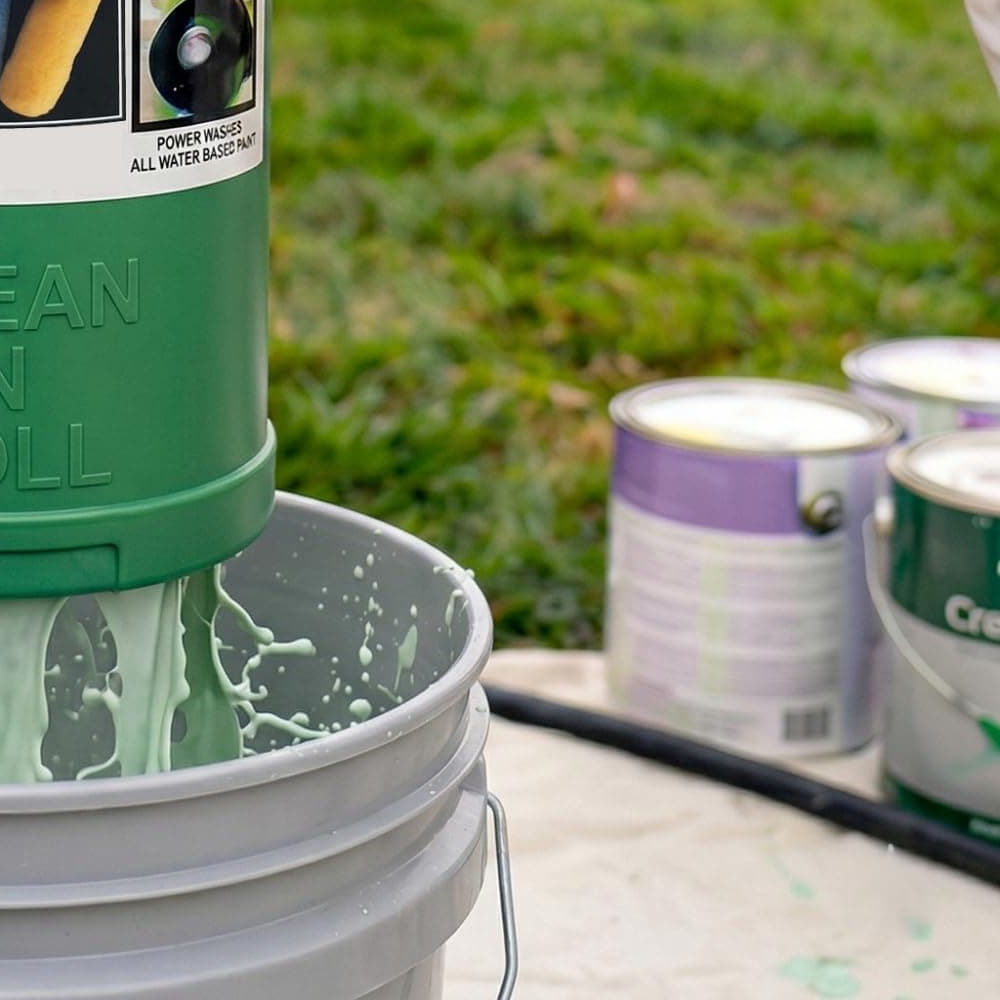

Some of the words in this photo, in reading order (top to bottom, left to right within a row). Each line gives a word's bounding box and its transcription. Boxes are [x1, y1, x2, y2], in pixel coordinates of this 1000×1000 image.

[157, 131, 201, 151] POWER
[130, 157, 156, 173] ALL
[159, 151, 200, 169] WATER
[203, 142, 235, 162] BASED
